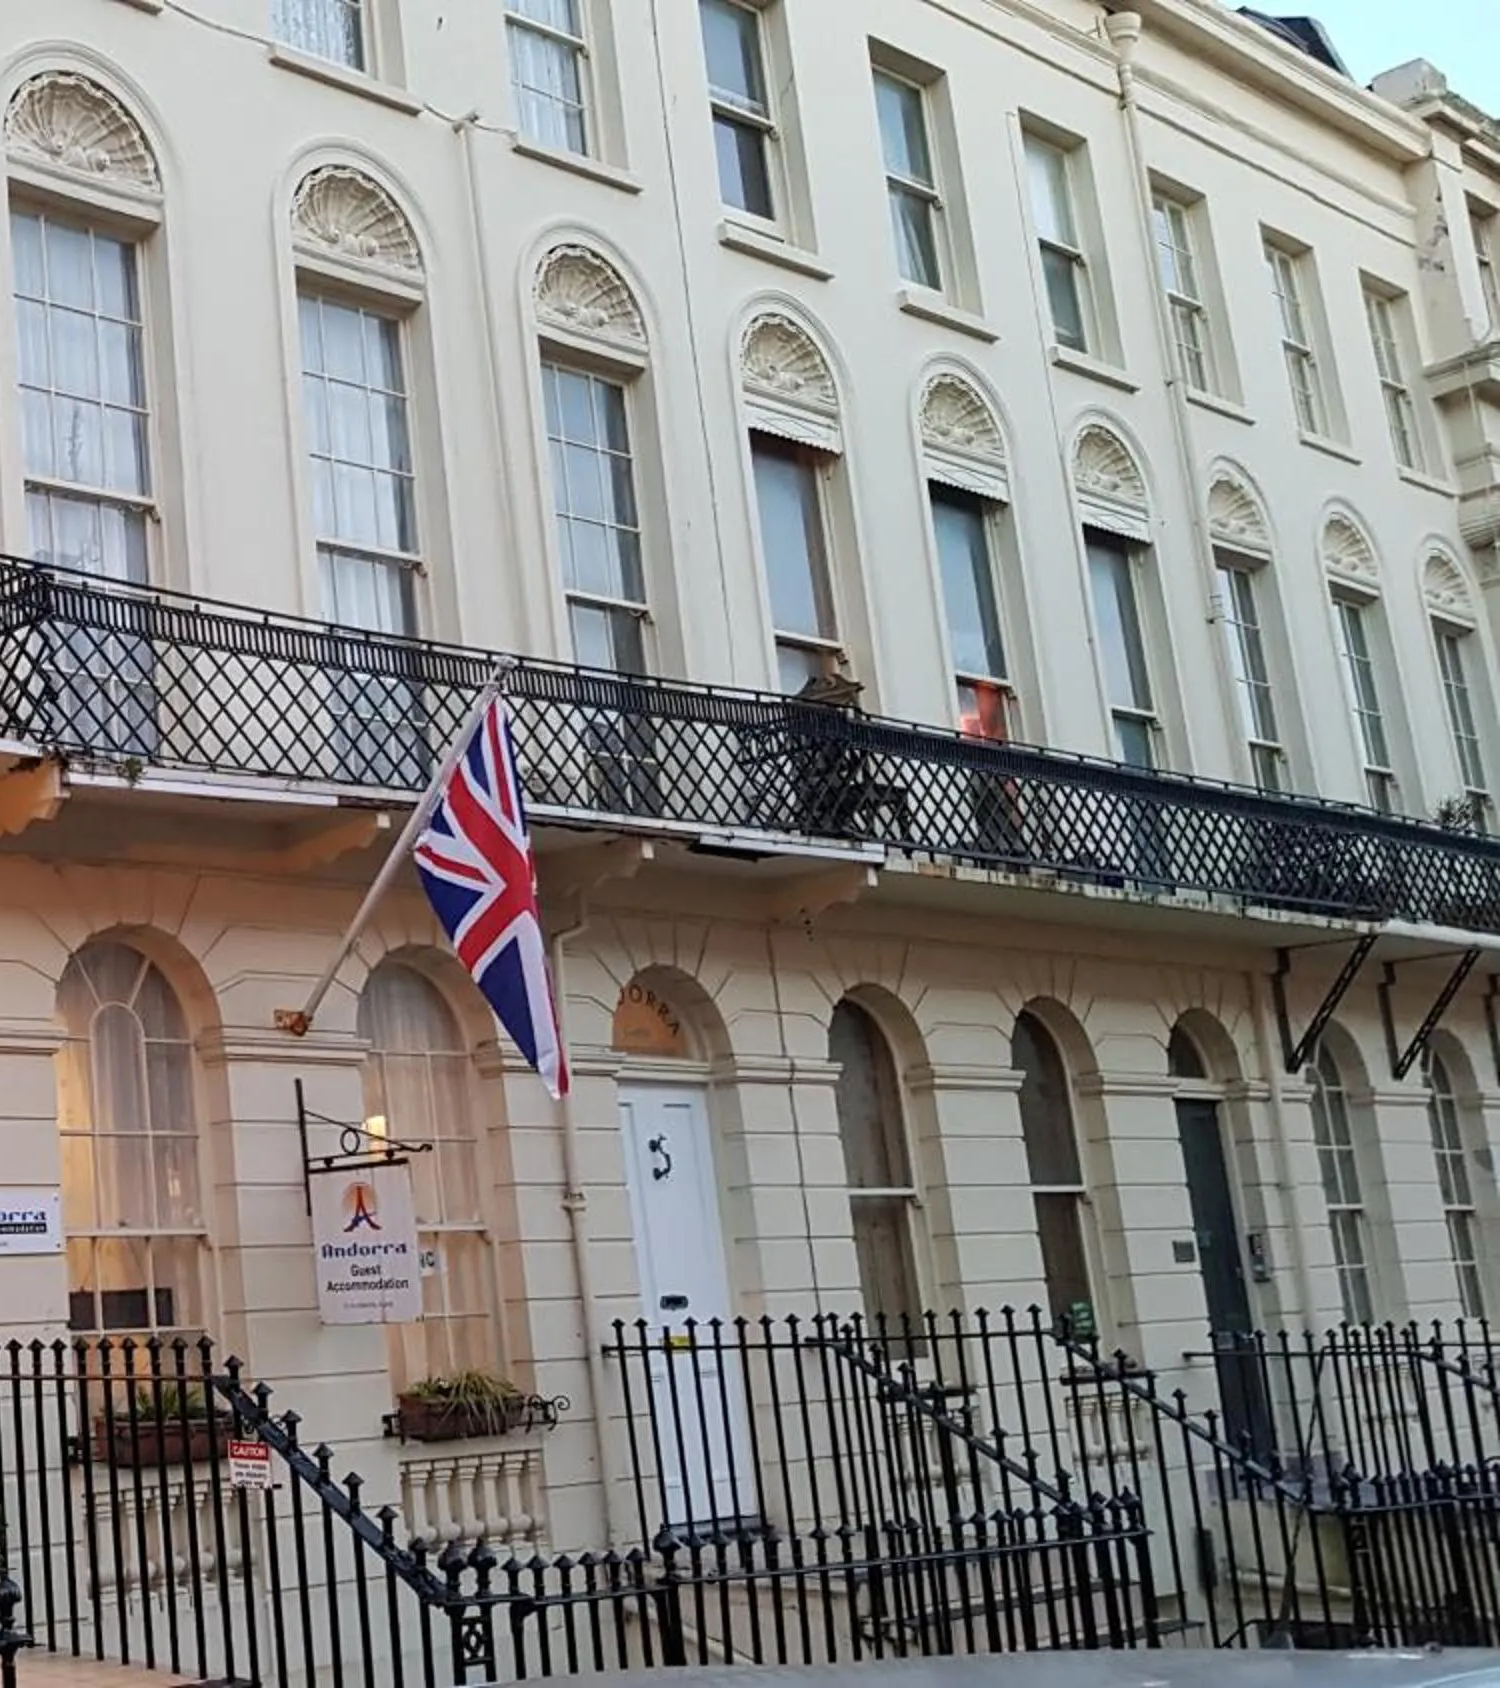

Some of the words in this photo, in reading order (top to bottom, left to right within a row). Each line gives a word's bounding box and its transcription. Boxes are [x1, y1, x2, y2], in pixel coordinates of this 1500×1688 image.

[322, 1242, 407, 1259] Andorra
[350, 1263, 381, 1276] Guest
[326, 1279, 409, 1292] Accommodation
